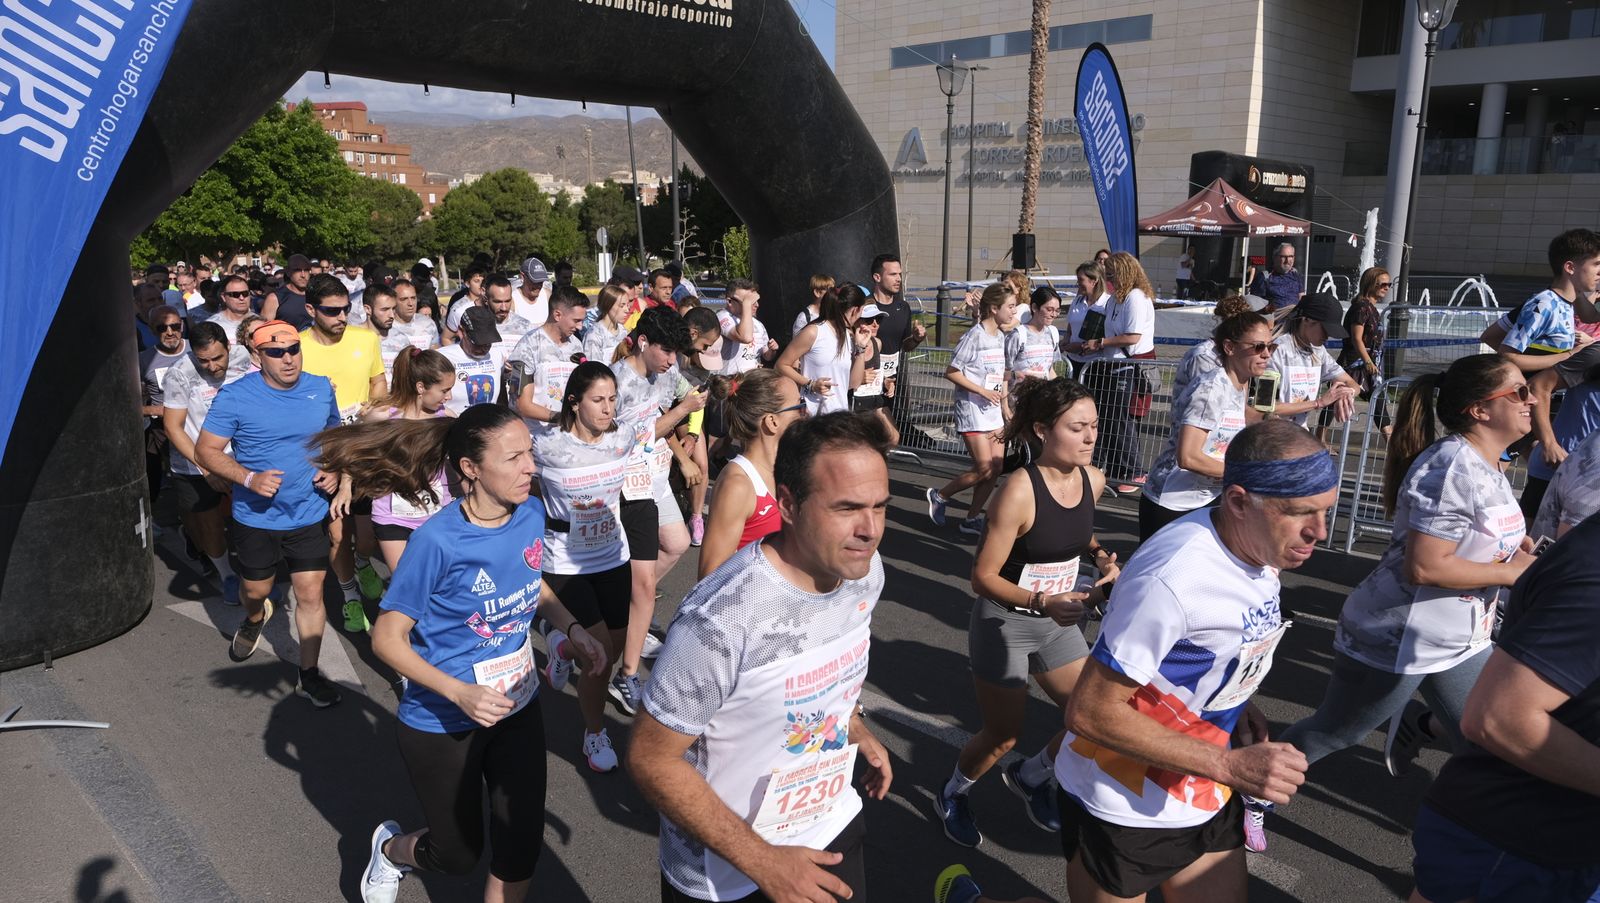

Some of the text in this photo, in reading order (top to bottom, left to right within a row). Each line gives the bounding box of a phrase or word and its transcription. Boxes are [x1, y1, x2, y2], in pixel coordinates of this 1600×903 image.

[671, 4, 733, 28] deportivo
[77, 0, 178, 181] centrohogarsanch
[625, 474, 651, 488] 1038
[579, 517, 616, 537] 1185
[471, 582, 496, 592] ALTEA
[1031, 575, 1074, 595] 1215
[498, 588, 525, 608] Runner
[798, 659, 839, 688] CARRERA
[840, 650, 853, 668] SIN
[777, 774, 845, 814] 1230
